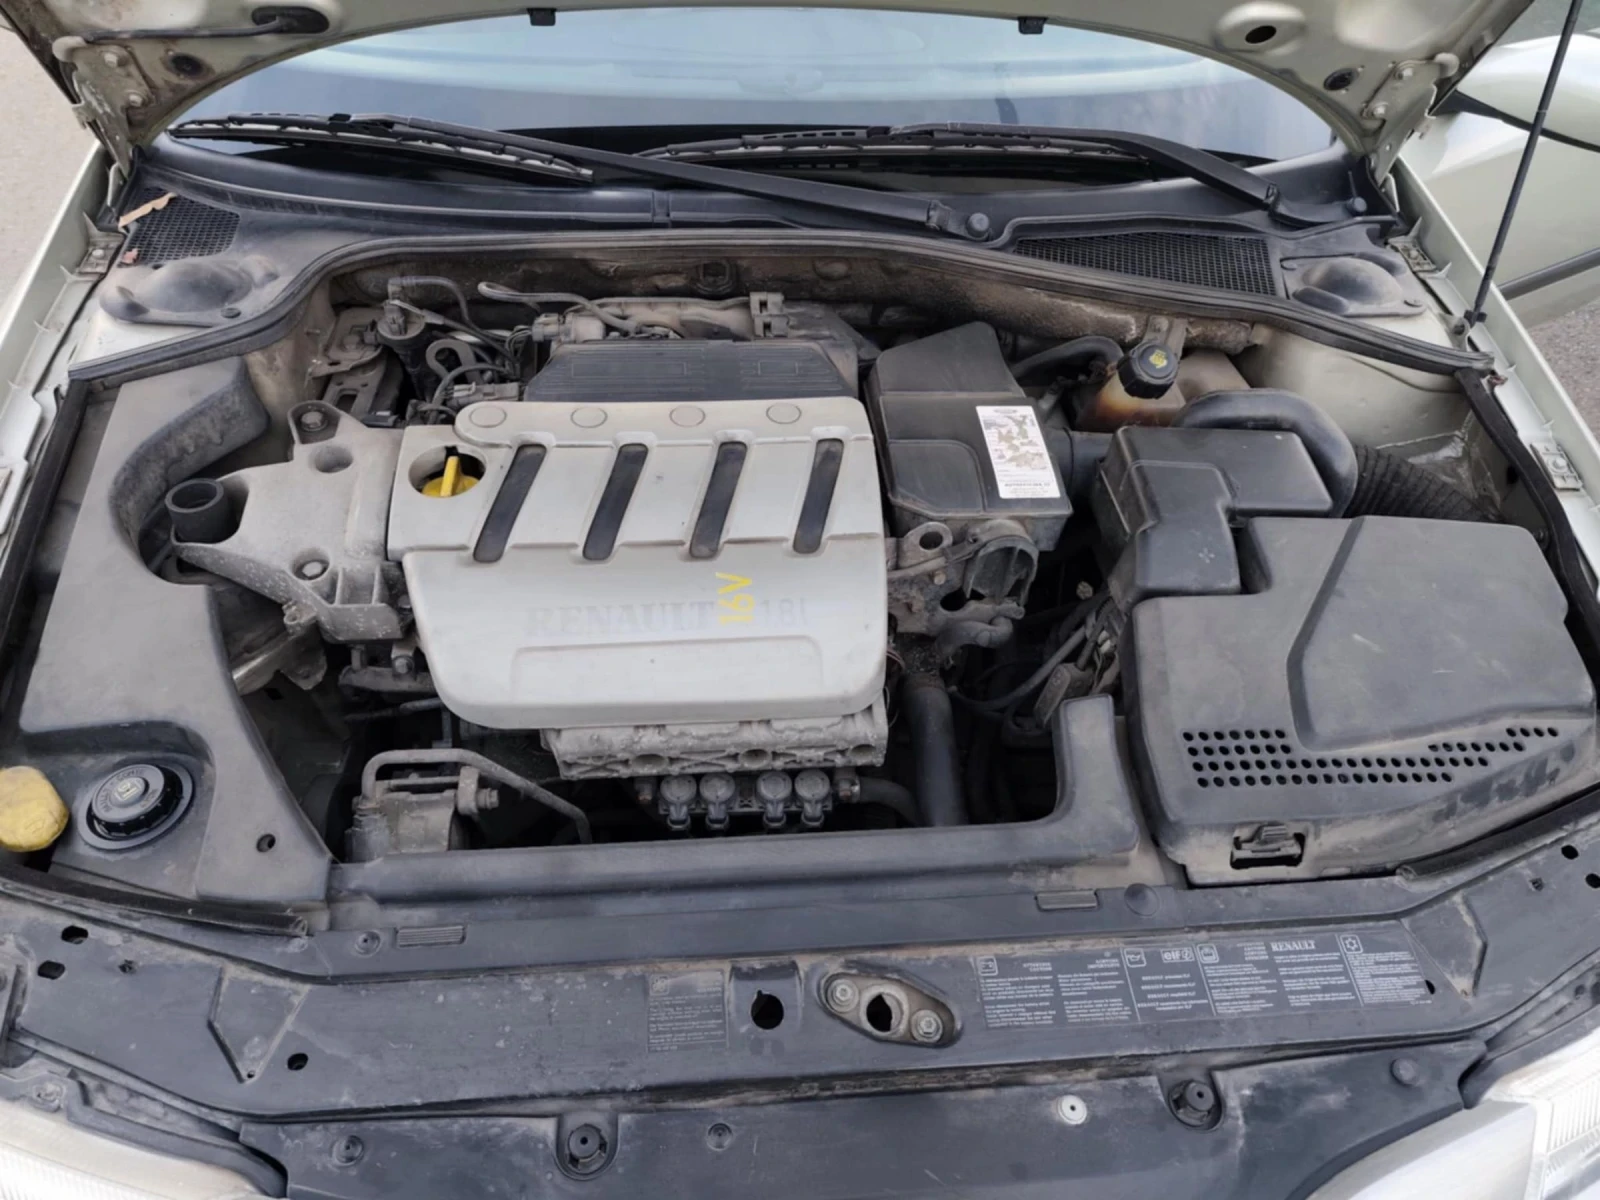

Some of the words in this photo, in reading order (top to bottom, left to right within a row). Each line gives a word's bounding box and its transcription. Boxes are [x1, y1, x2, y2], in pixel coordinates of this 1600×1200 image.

[715, 571, 756, 627] 16V
[524, 600, 715, 637] RENAULT
[1270, 939, 1316, 952] RENAULT
